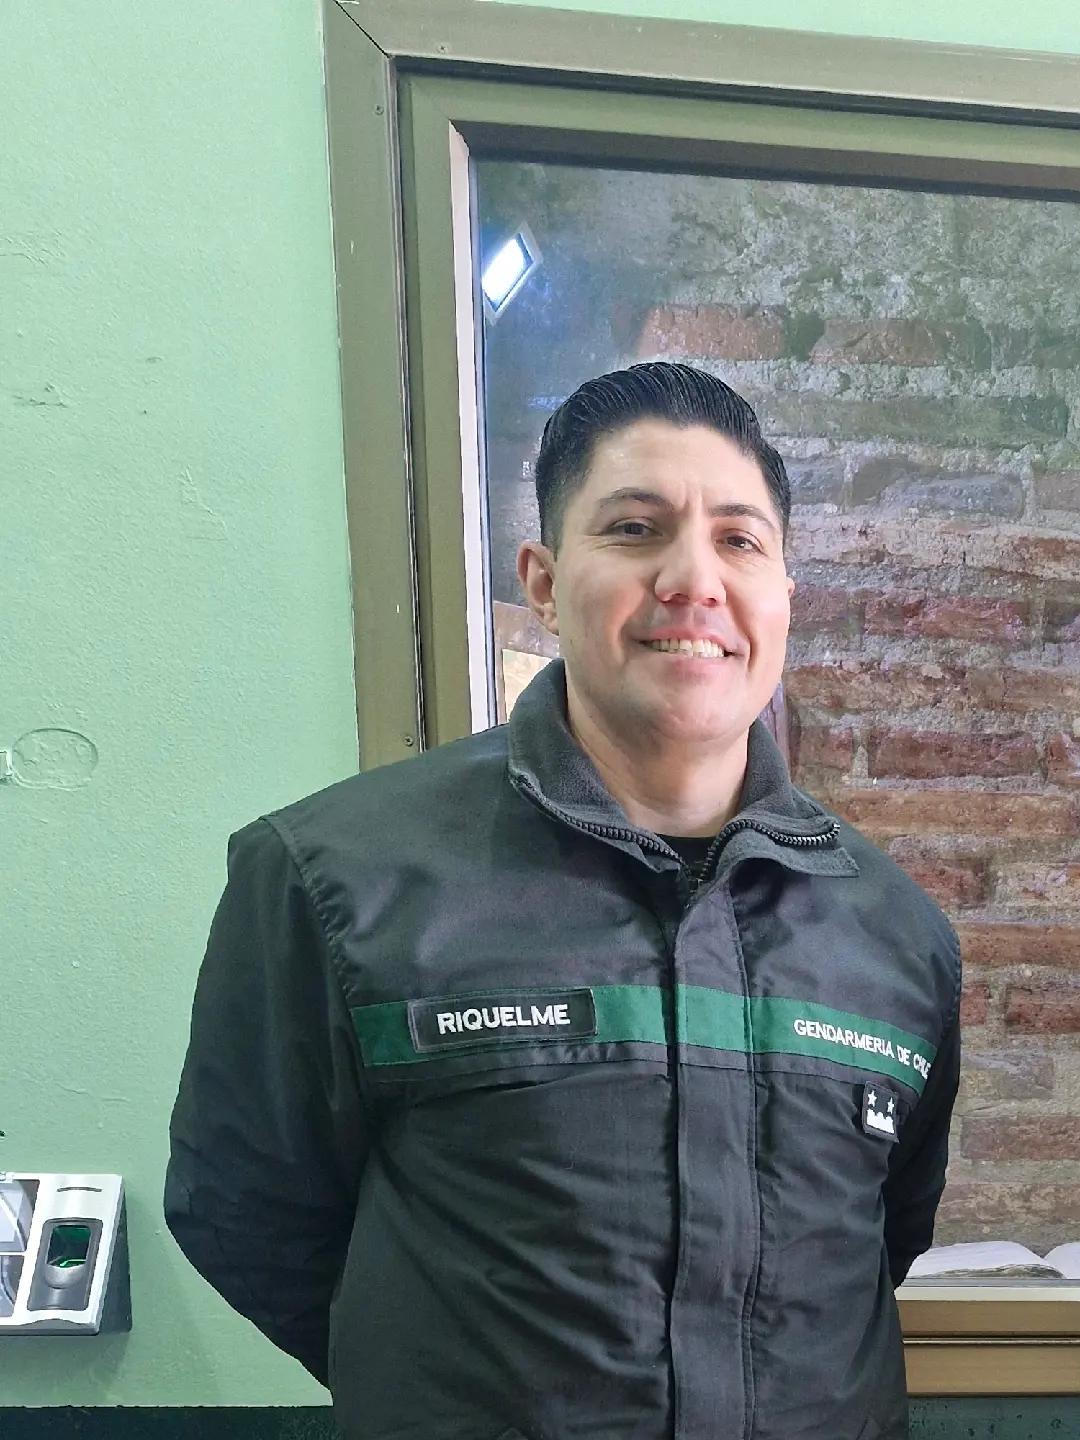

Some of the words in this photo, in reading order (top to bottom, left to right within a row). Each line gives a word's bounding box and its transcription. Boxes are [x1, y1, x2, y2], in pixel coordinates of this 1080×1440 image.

[437, 1004, 570, 1034] RIQUELME
[794, 1019, 895, 1058] GENDARMERIA
[897, 1044, 911, 1066] DE
